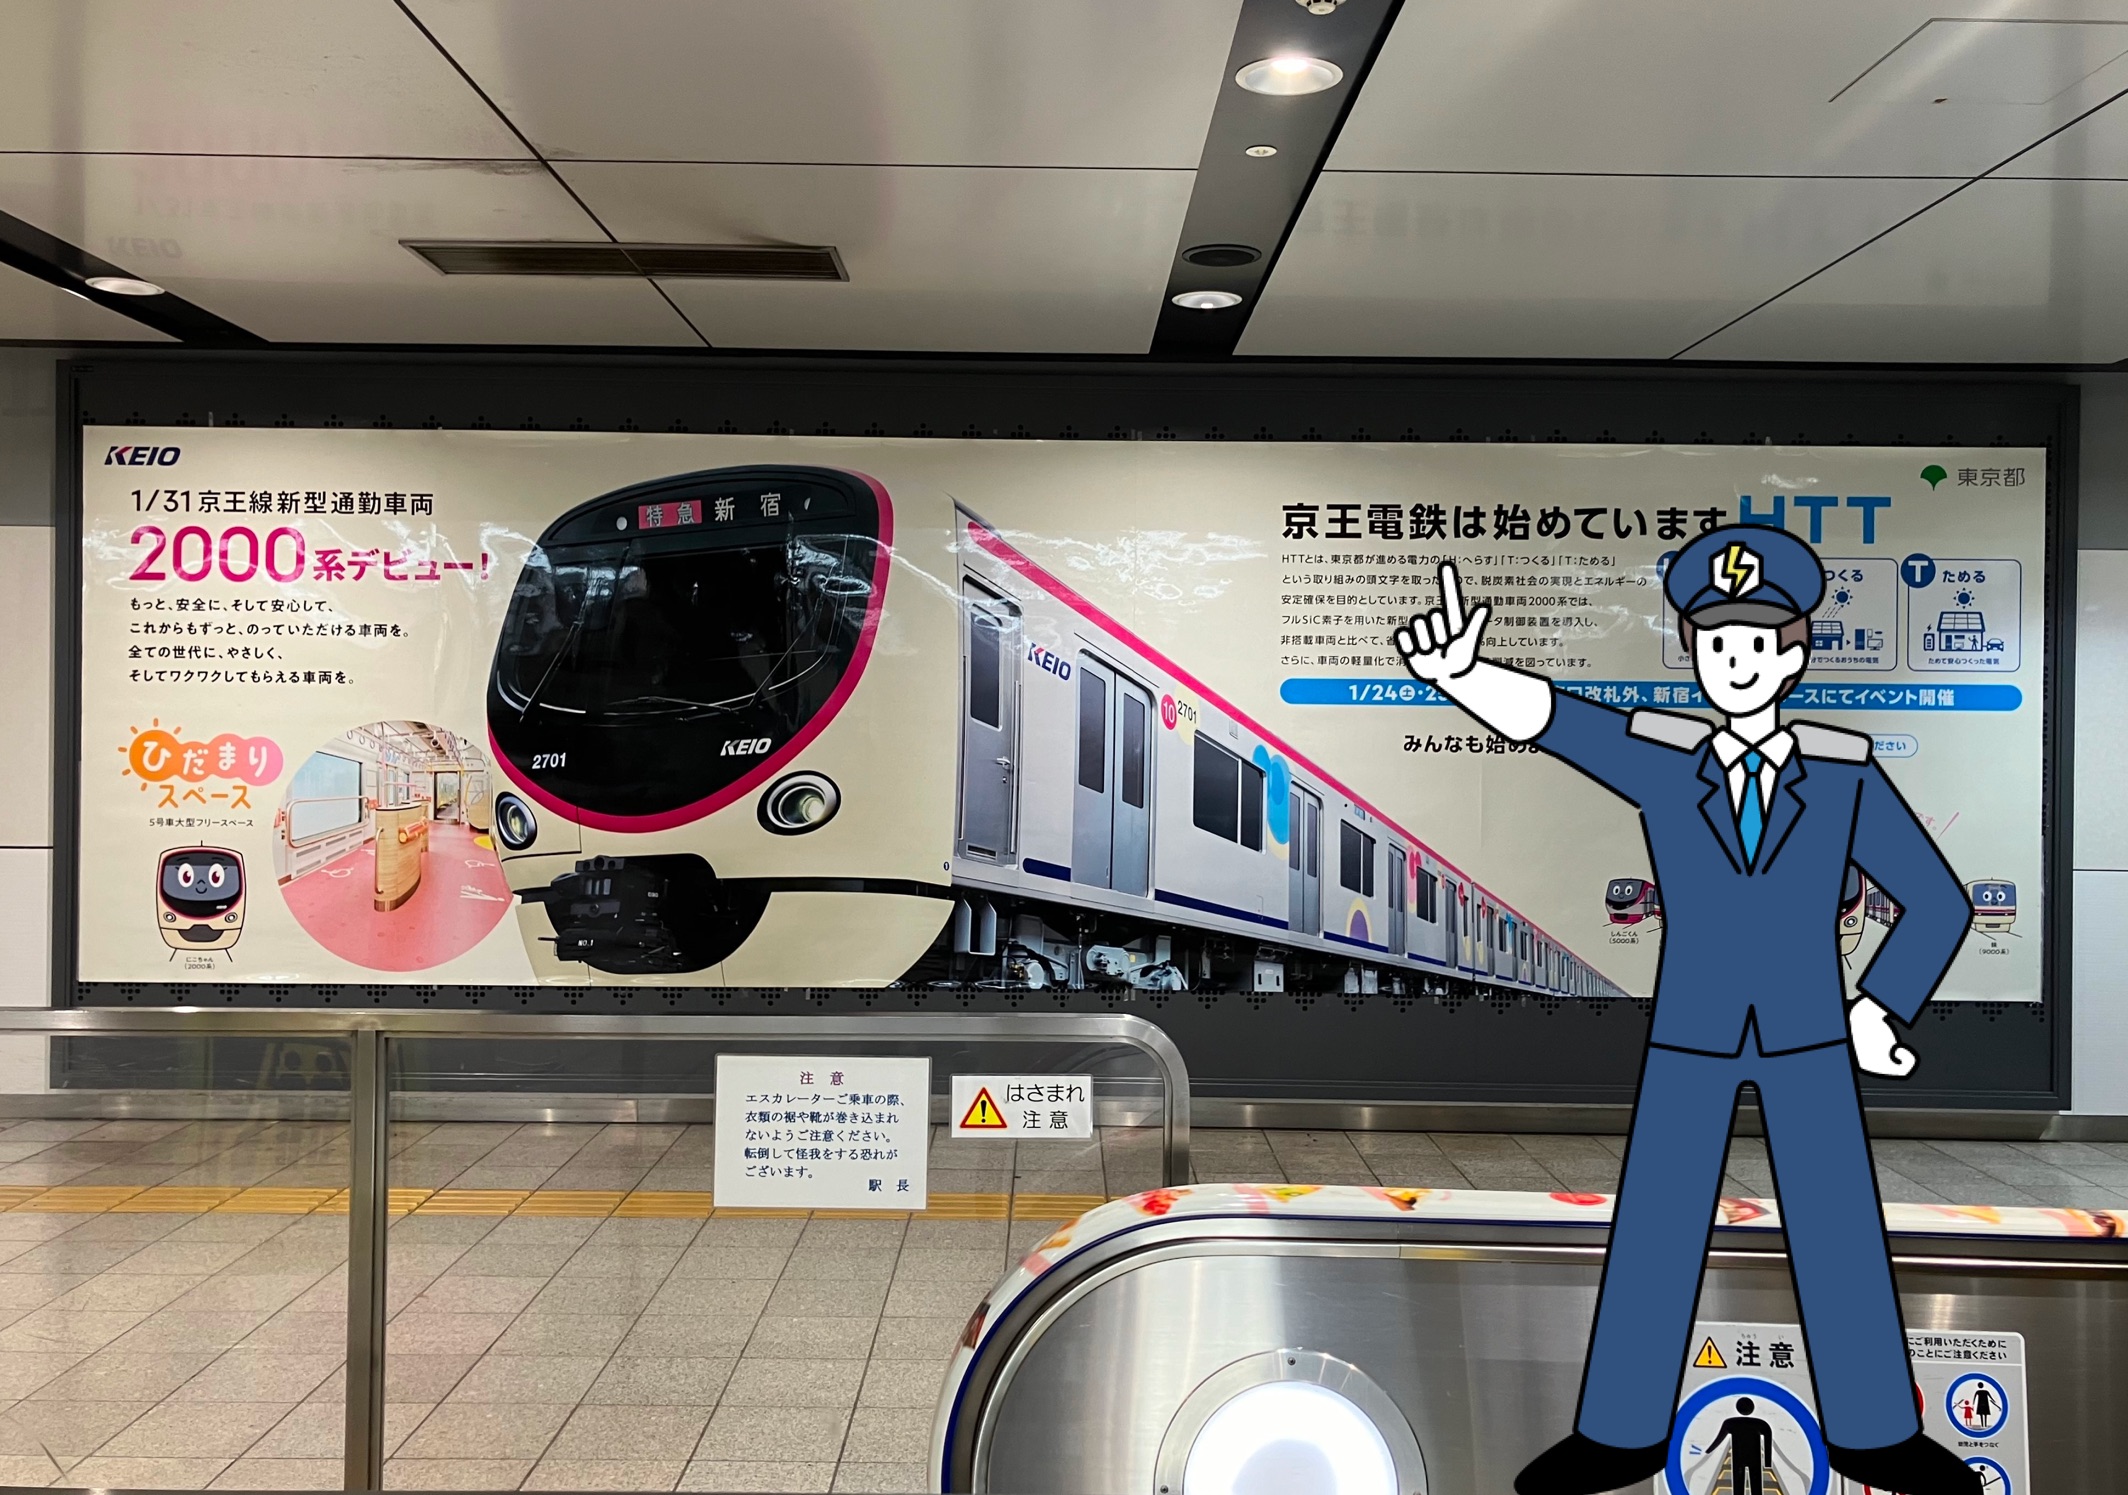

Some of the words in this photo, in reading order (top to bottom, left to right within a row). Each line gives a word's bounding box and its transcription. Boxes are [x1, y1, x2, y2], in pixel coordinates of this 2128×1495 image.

[104, 446, 181, 466] KEIO
[1957, 467, 2025, 487] 東京都
[646, 502, 696, 527] 特急
[714, 492, 781, 522] 新宿
[1282, 502, 1727, 541] 京王電鉄は始めています
[1739, 495, 1892, 545] HTT
[1908, 560, 1929, 582] T
[1942, 569, 1986, 584] ためる
[129, 597, 334, 613] もっと、安全に、そして安心して、
[129, 621, 409, 638] これからもずっと、のっていただける車両を。
[128, 645, 284, 660] 全ての世代に、やさしく、
[1028, 642, 1071, 681] KEIO
[128, 668, 354, 685] そしてワクワクしてもらえる車両を。
[1163, 701, 1175, 724] 10
[1177, 700, 1198, 724] 2701
[720, 737, 771, 756] KEIO
[143, 740, 267, 777] ひだまり
[532, 752, 567, 770] 2701
[157, 785, 252, 810] スペース
[149, 817, 254, 828] 5号車大型フリースペース
[745, 1093, 906, 1107] エスカレーターご乗車の際、
[1005, 1083, 1085, 1103] はさまれ
[745, 1111, 900, 1124] 衣類の裾や靴が巻き込まれ
[1022, 1110, 1069, 1130] 注意
[745, 1129, 893, 1143] ないようご注意ください。
[744, 1147, 898, 1160] 転倒して怪我をする恐れが
[745, 1165, 813, 1179] ございます。
[1736, 1340, 1795, 1368] 注意
